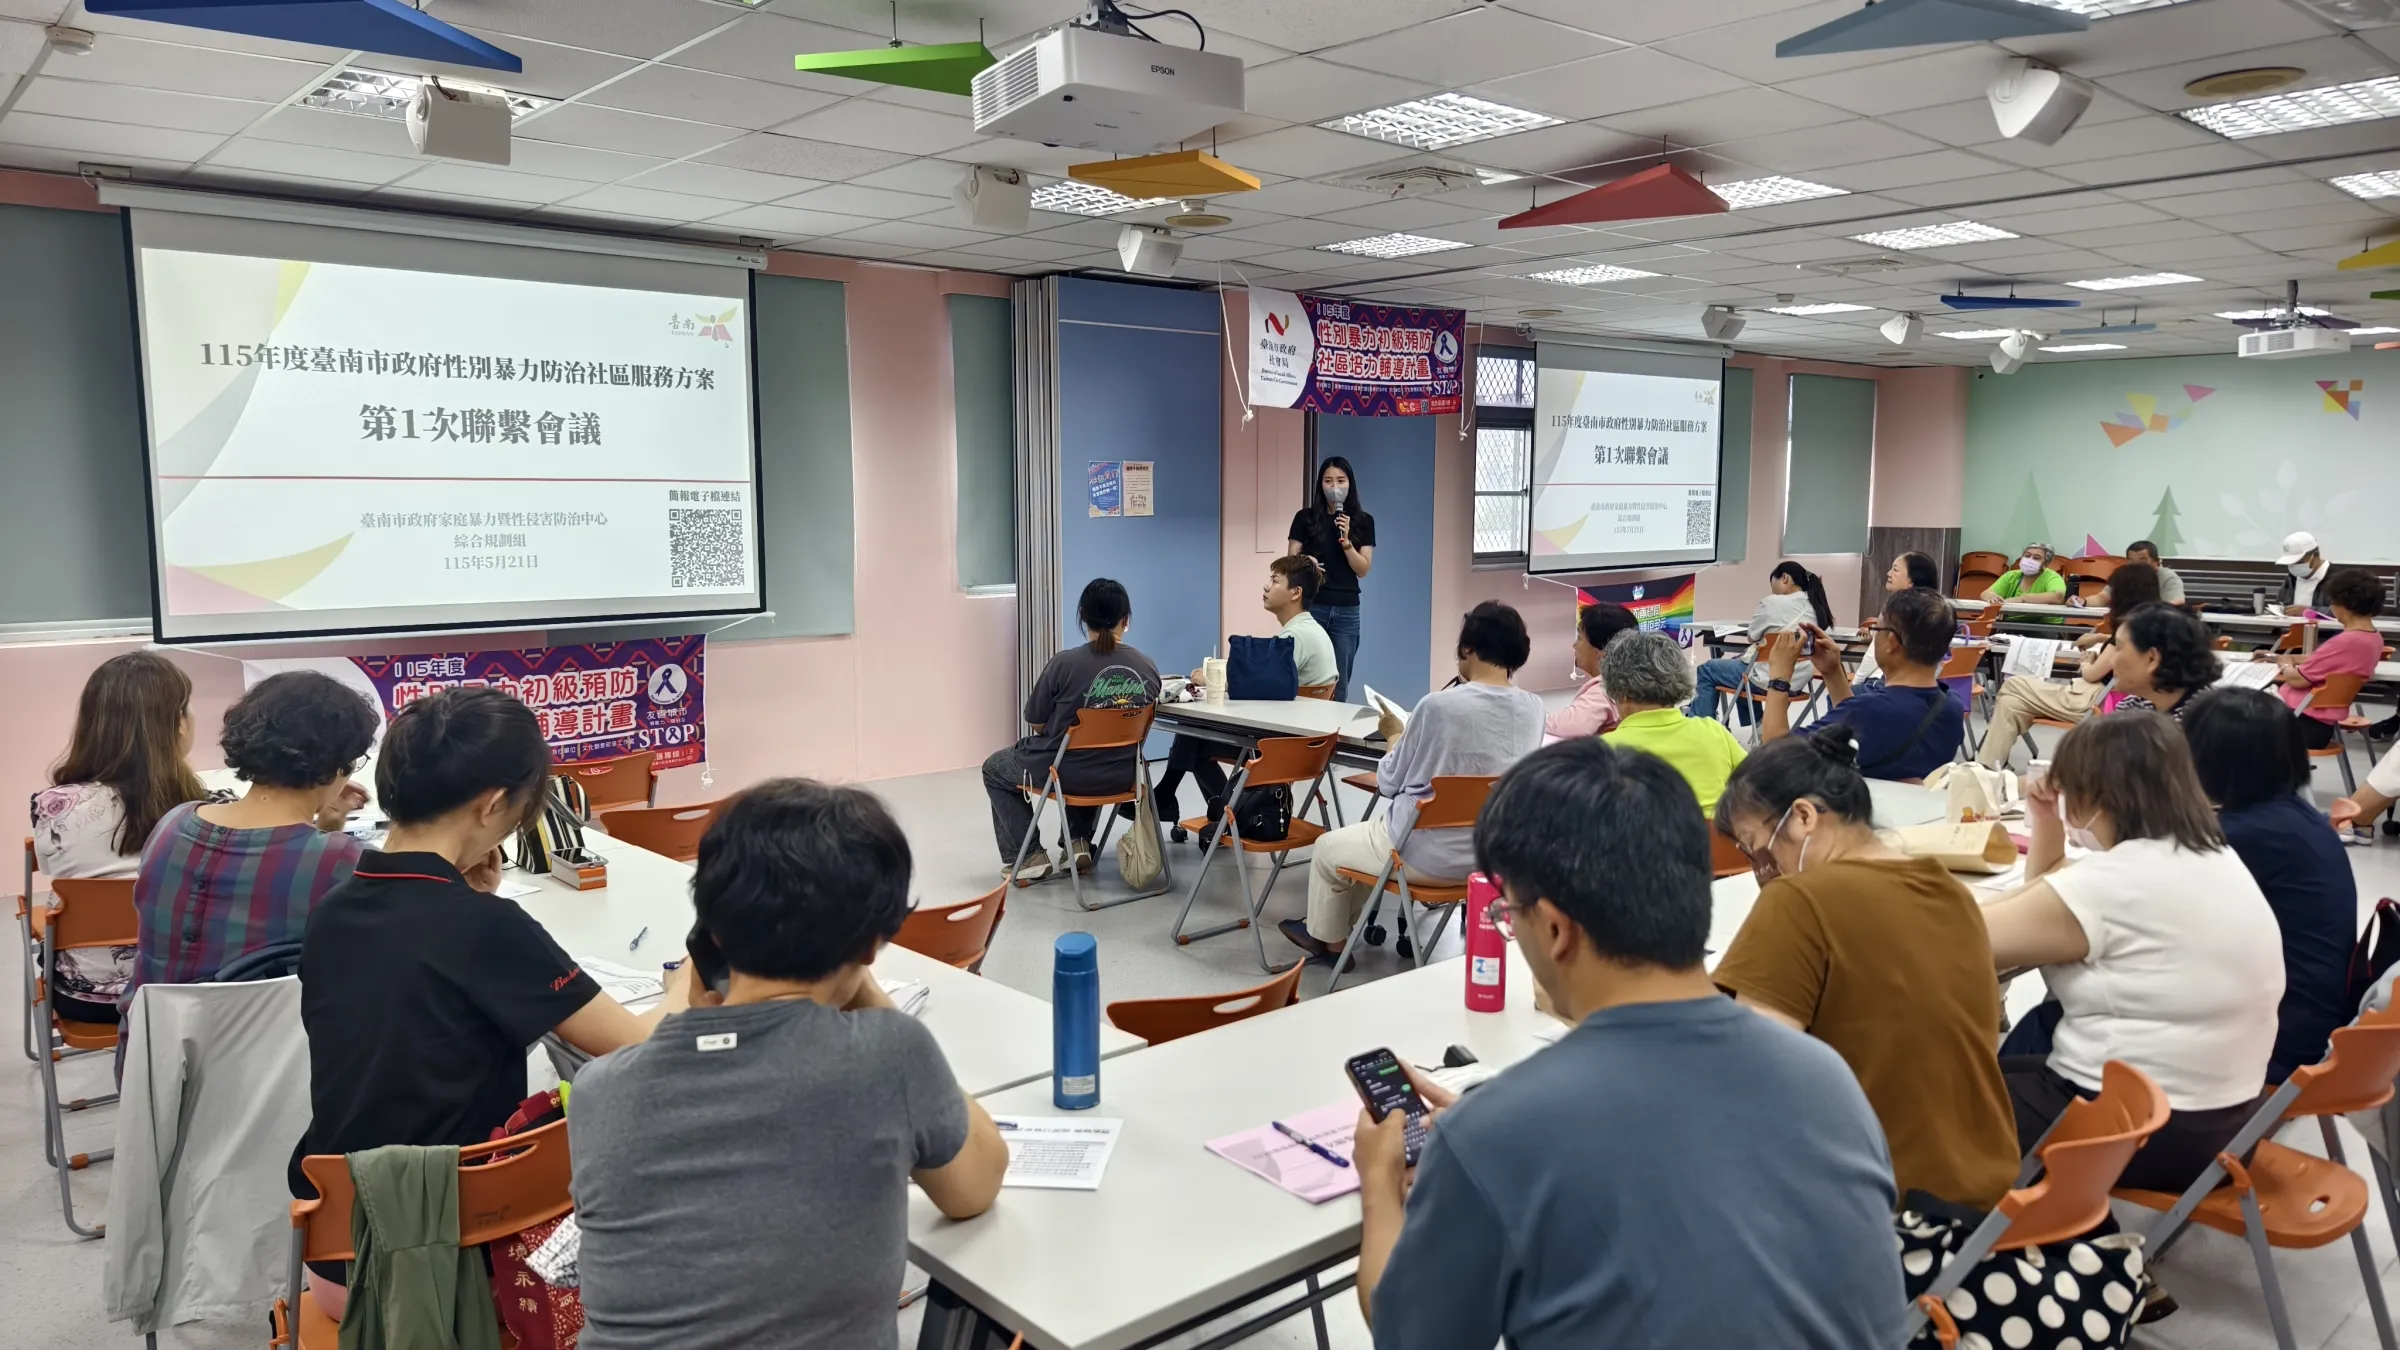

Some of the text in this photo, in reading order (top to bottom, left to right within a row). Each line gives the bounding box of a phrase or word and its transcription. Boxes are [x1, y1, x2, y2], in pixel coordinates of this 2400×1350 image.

[1151, 65, 1175, 76] EPSON
[1316, 303, 1350, 320] 115年度
[1317, 320, 1433, 353] 性別暴力初級預防
[200, 343, 715, 390] 115年度臺南市政府性別暴力防治社區服務方案
[1316, 349, 1432, 380] 社區培力輔導計畫
[359, 404, 601, 446] 第1次聯繫會議
[1594, 445, 1669, 466] 第1次聯繫會議
[669, 490, 741, 502] 簡報電子檔連結
[360, 511, 608, 528] 臺南市政府家庭暴力暨性侵害防治中心
[454, 533, 527, 549] 綜合規劃組
[444, 554, 538, 570] 115年5月21日
[394, 656, 465, 678] 115年度
